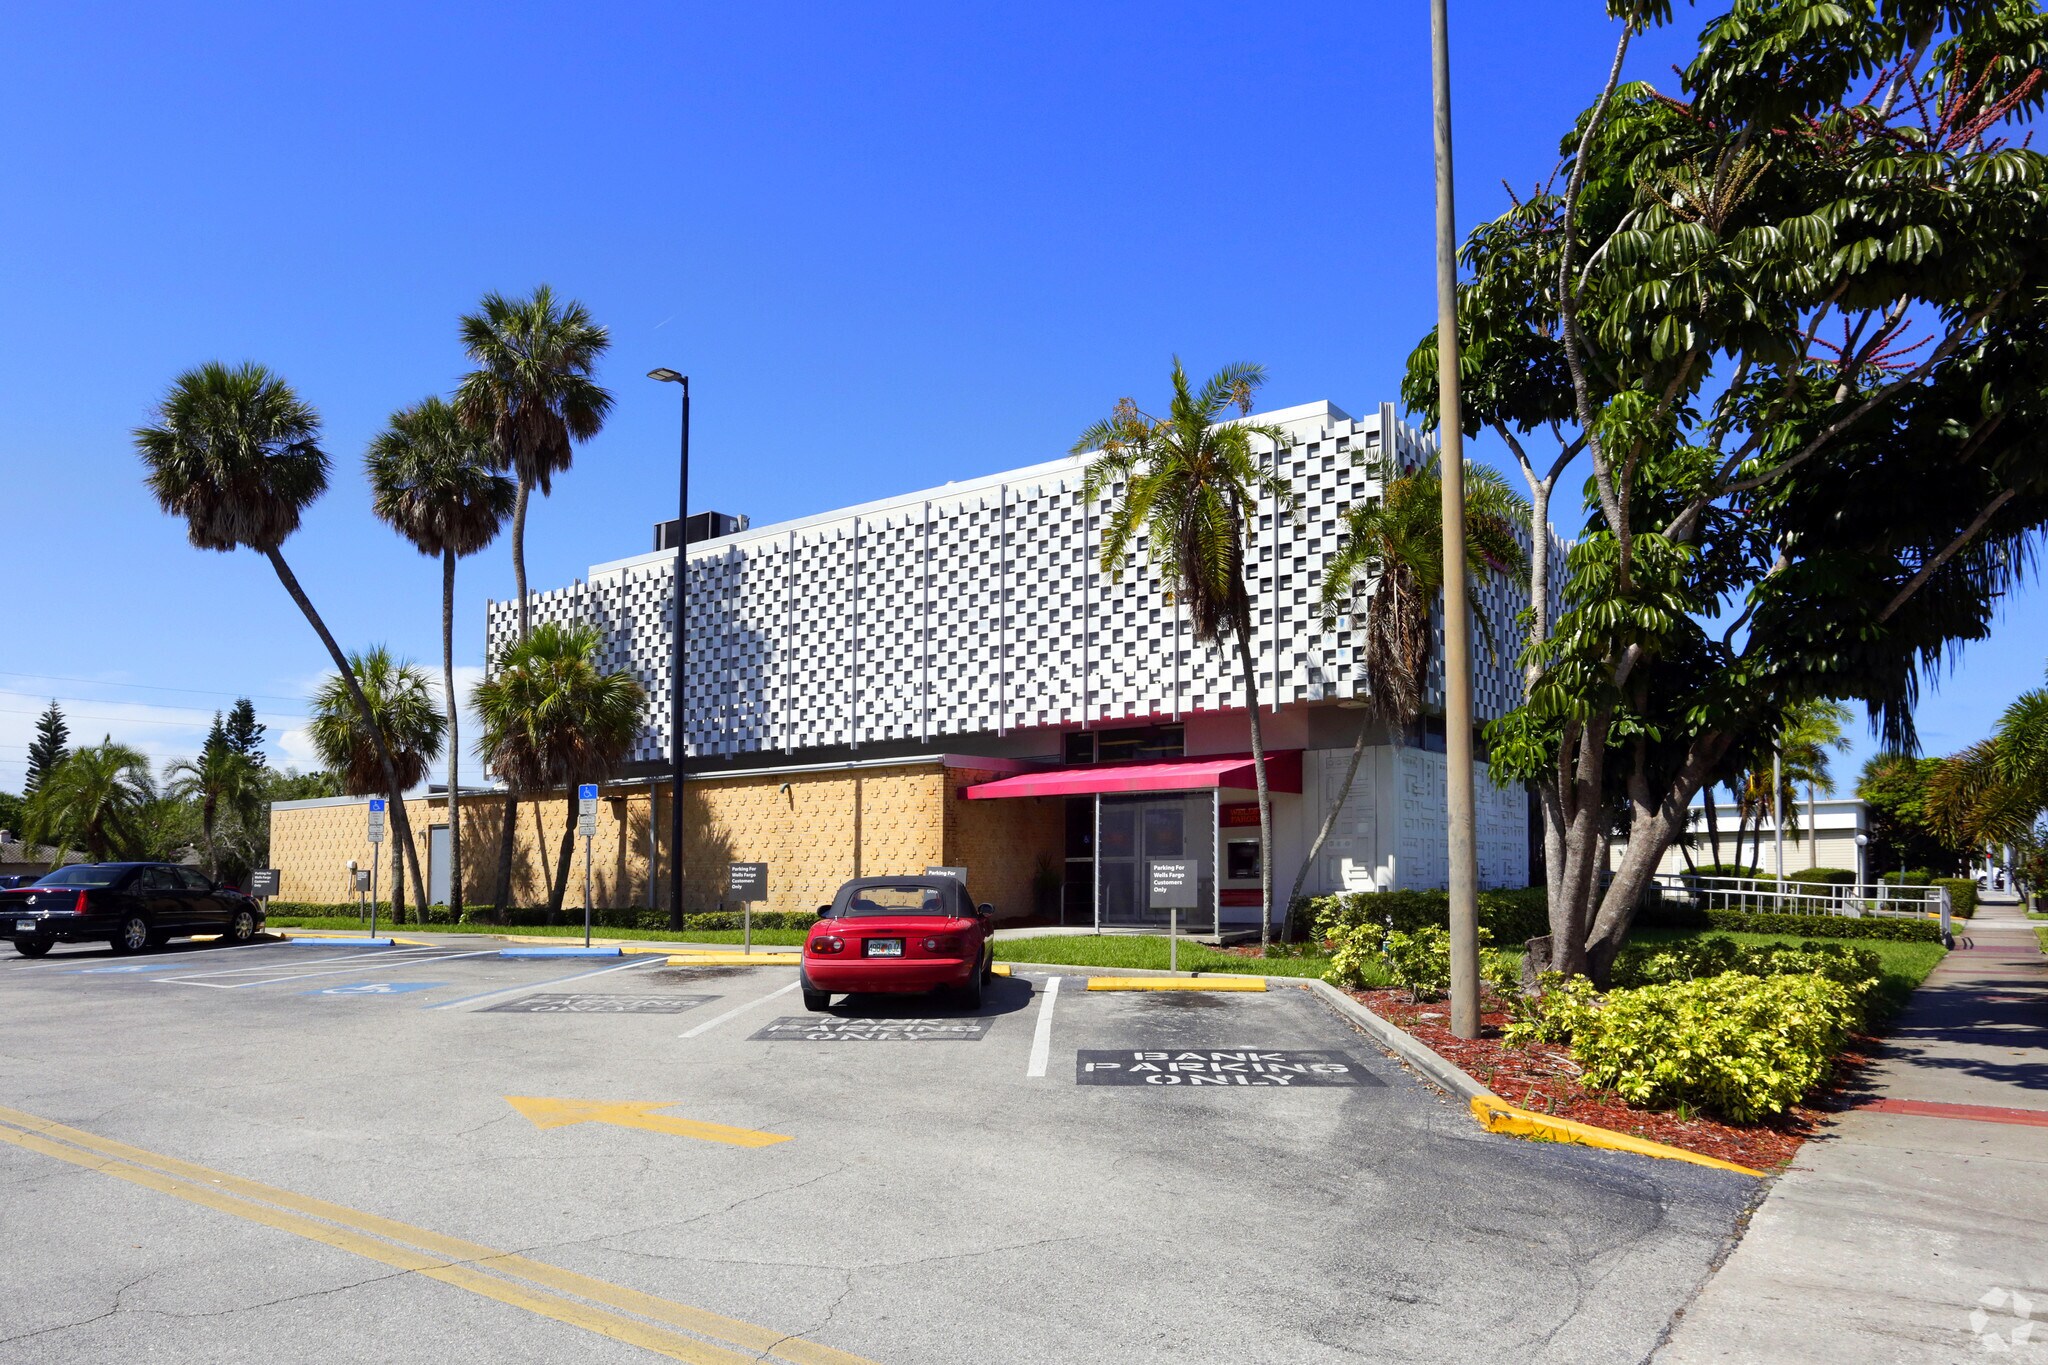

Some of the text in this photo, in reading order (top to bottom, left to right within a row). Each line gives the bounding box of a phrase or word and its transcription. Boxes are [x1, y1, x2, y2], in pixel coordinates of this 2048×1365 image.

[1134, 1052, 1286, 1062] BANK
[1085, 1062, 1349, 1073] PARKING
[1146, 1074, 1294, 1086] ONLY
